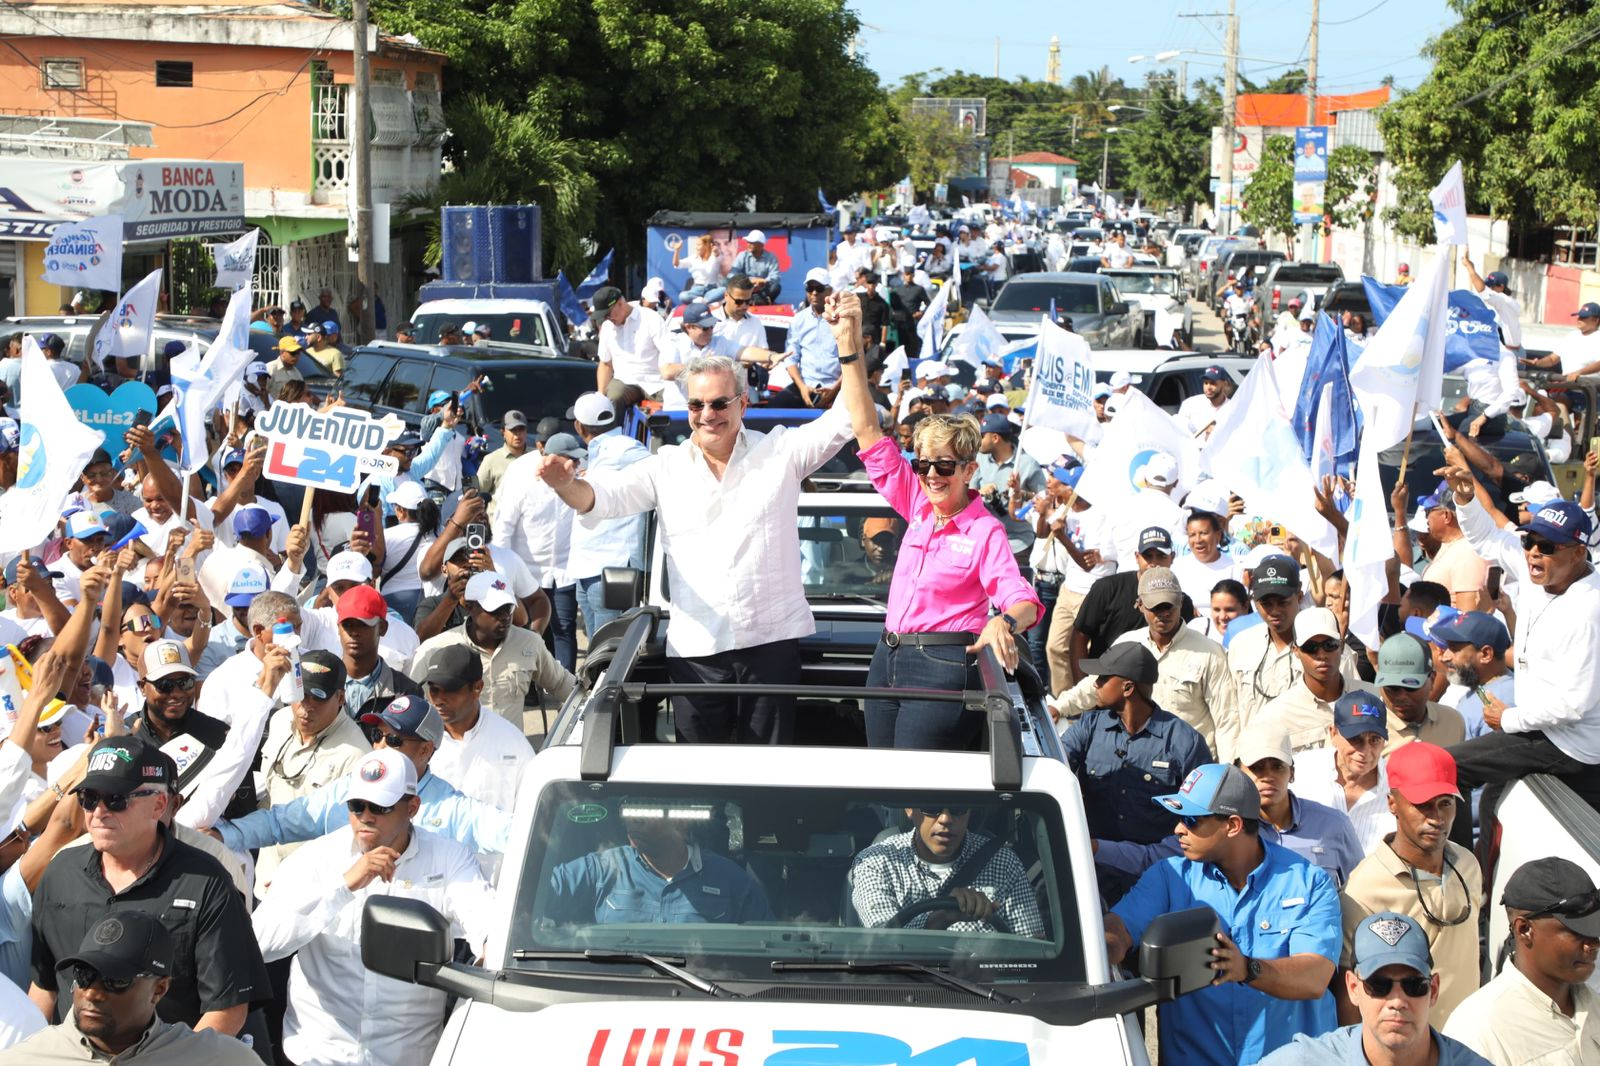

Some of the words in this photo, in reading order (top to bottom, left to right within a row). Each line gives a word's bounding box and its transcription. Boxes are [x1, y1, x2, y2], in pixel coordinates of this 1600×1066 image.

[162, 167, 215, 187] BANCA
[149, 188, 228, 214] MODA
[136, 221, 189, 236] SEGURIDAD
[190, 220, 199, 231] Y
[199, 218, 242, 231] PRESTIGIO
[73, 408, 134, 425] #Luis2
[268, 442, 358, 488] L24
[1351, 704, 1379, 718] L24
